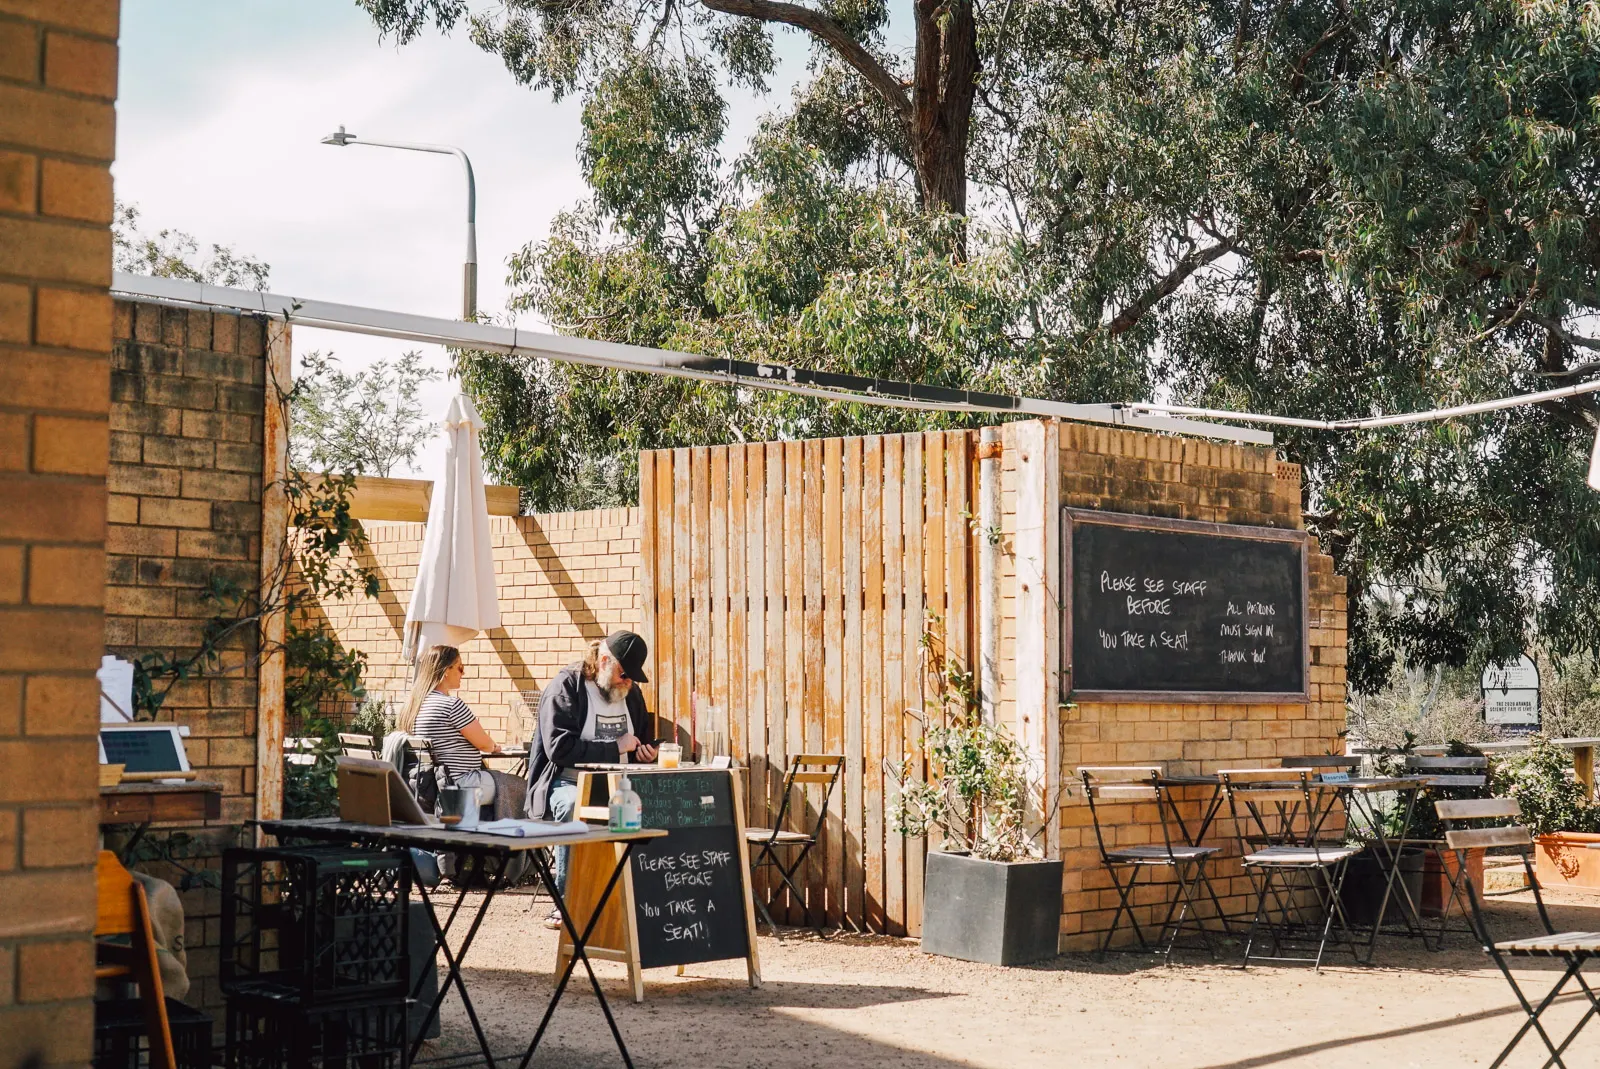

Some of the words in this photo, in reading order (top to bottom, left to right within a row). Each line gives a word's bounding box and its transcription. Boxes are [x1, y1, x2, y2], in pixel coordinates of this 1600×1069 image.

[1101, 570, 1136, 593] PLEASE
[1144, 577, 1165, 593] SEE
[1172, 580, 1207, 596] STAFF
[1126, 595, 1171, 615] BEFORE
[1226, 600, 1243, 616] ALL
[1099, 628, 1118, 649] YOU
[1121, 630, 1146, 649] TAKE
[1150, 634, 1158, 648] A
[1160, 629, 1189, 651] SEAT!
[1220, 623, 1241, 637] MUST
[1244, 624, 1263, 637] SIGN
[1265, 623, 1274, 638] IN
[1219, 649, 1247, 664] THANK
[638, 853, 676, 872] PLEASE
[679, 852, 701, 870] SEE
[702, 850, 732, 868] STAFF
[664, 871, 714, 891] BEFORE
[639, 901, 660, 918] YOU
[665, 898, 697, 917] TAKE
[707, 899, 716, 913] A
[663, 920, 705, 942] SEAT!
